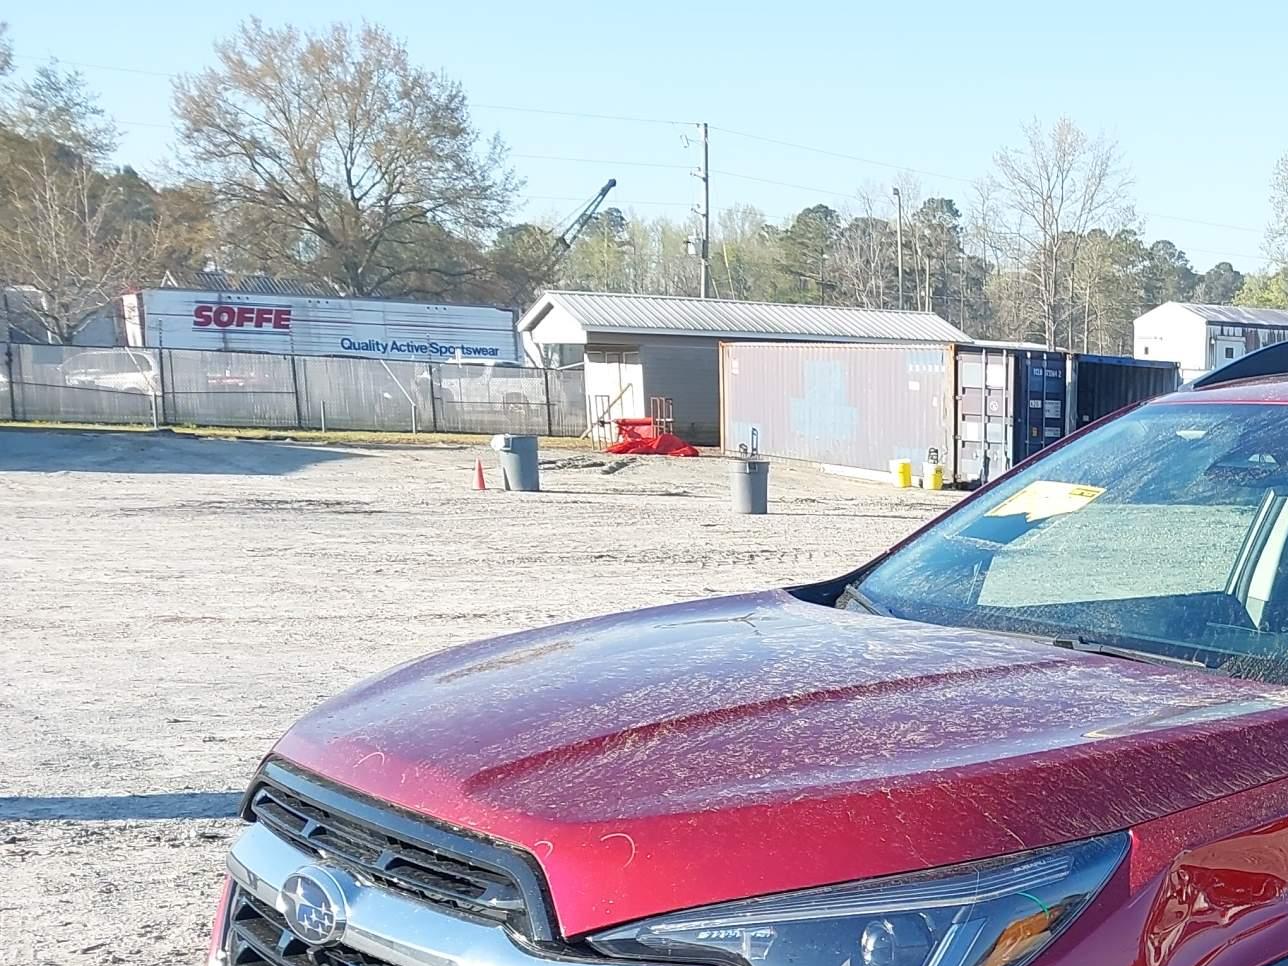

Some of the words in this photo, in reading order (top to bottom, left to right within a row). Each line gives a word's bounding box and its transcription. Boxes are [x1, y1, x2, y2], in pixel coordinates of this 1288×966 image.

[193, 305, 291, 329] SOFFE
[341, 338, 388, 354] Quality
[390, 340, 427, 354] Active
